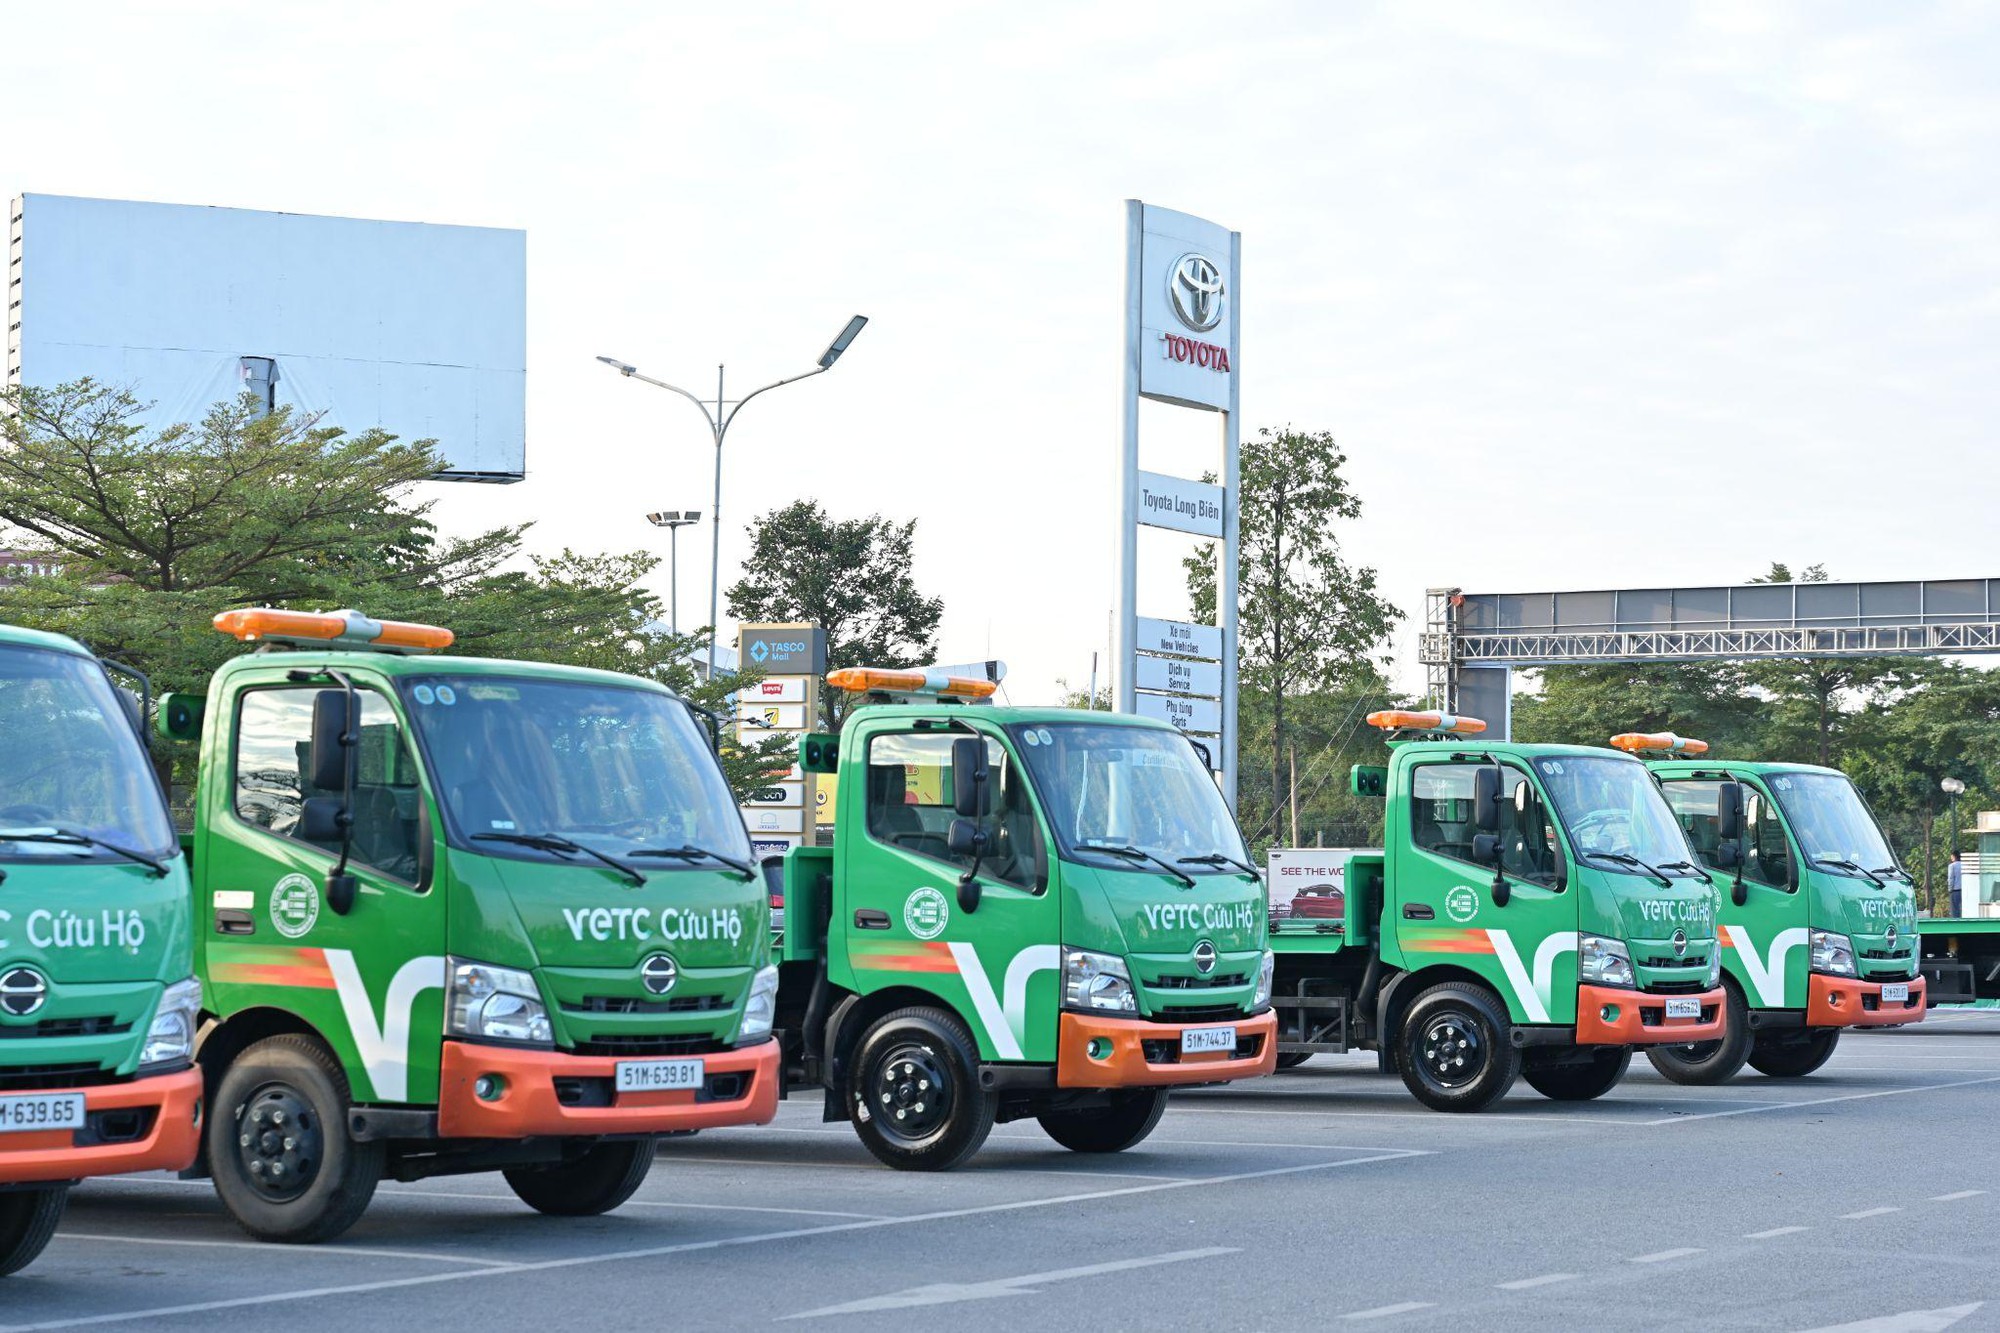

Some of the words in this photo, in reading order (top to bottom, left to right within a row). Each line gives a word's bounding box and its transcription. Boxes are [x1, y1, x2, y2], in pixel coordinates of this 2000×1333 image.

[1165, 333, 1230, 372] TOYOTA
[1143, 489, 1172, 512] Toyota
[1175, 495, 1196, 519] Long
[1199, 500, 1219, 520] Biên
[1170, 625, 1178, 638] Xe
[770, 642, 805, 653] TASCO
[1161, 638, 1173, 650] New
[1175, 640, 1199, 654] Vehicles
[772, 653, 789, 661] Mall
[1168, 662, 1182, 677] Dịch
[1168, 678, 1191, 690] Service
[1166, 700, 1177, 716] Phụ
[1171, 716, 1187, 727] Parts
[1281, 867, 1302, 876] SEE
[1303, 867, 1326, 876] THE
[661, 908, 708, 941] Cứu
[712, 908, 741, 947] Hộ
[1203, 904, 1233, 930] Cứu
[1235, 904, 1253, 935] Hộ
[26, 909, 95, 948] Cứu
[102, 909, 145, 955] Hộ
[1187, 1031, 1231, 1048] 51M-744.37
[625, 1065, 695, 1085] 51M-639.81
